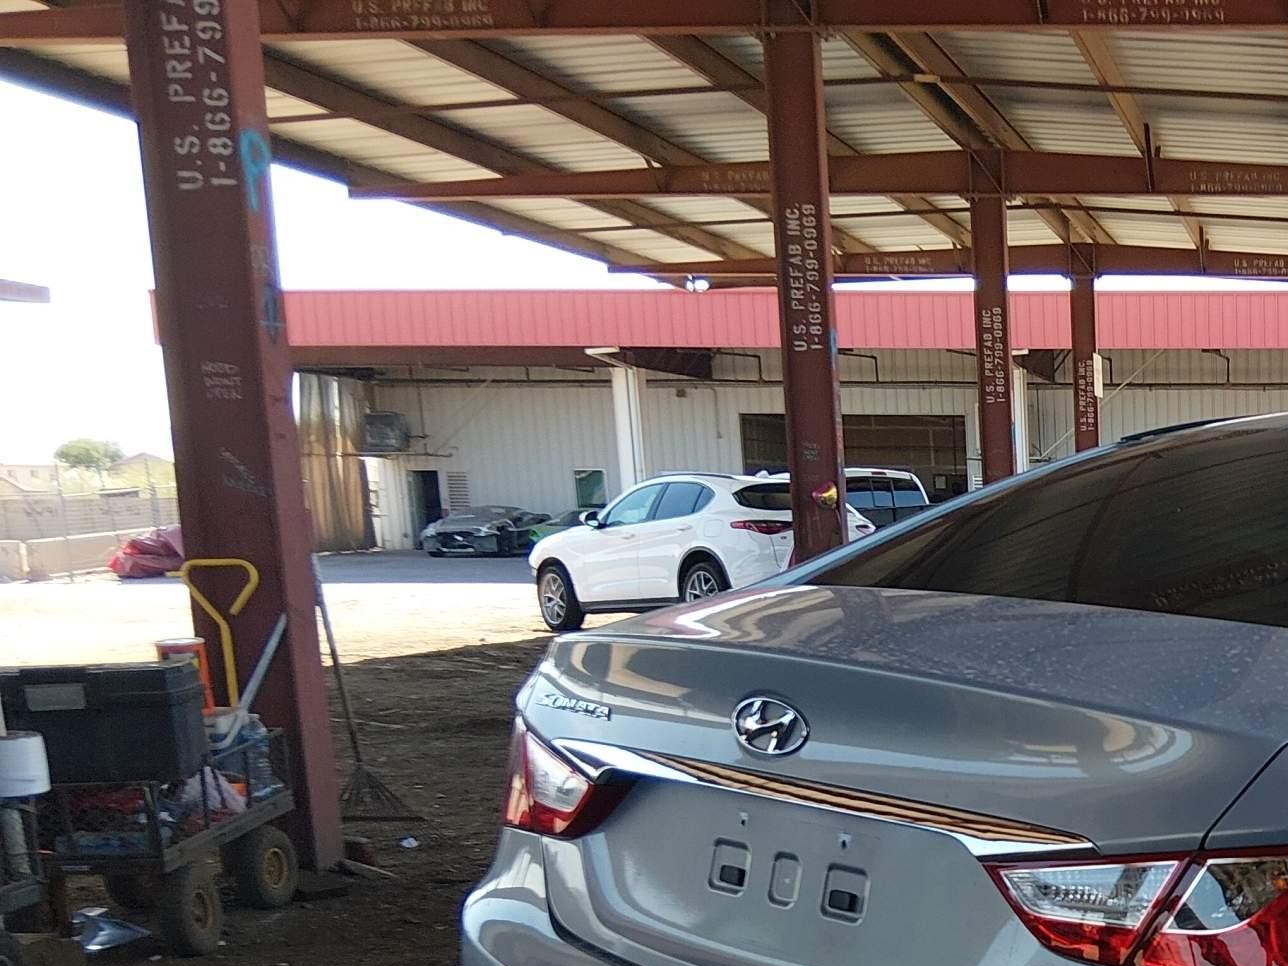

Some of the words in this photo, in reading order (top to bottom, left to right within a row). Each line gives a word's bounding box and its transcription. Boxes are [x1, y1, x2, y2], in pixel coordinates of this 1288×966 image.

[175, 124, 204, 190] U.S.
[785, 202, 802, 236] INC.
[788, 244, 805, 310] PREFAB
[802, 203, 824, 351] 1-866-799-0969
[793, 319, 808, 352] U.S.
